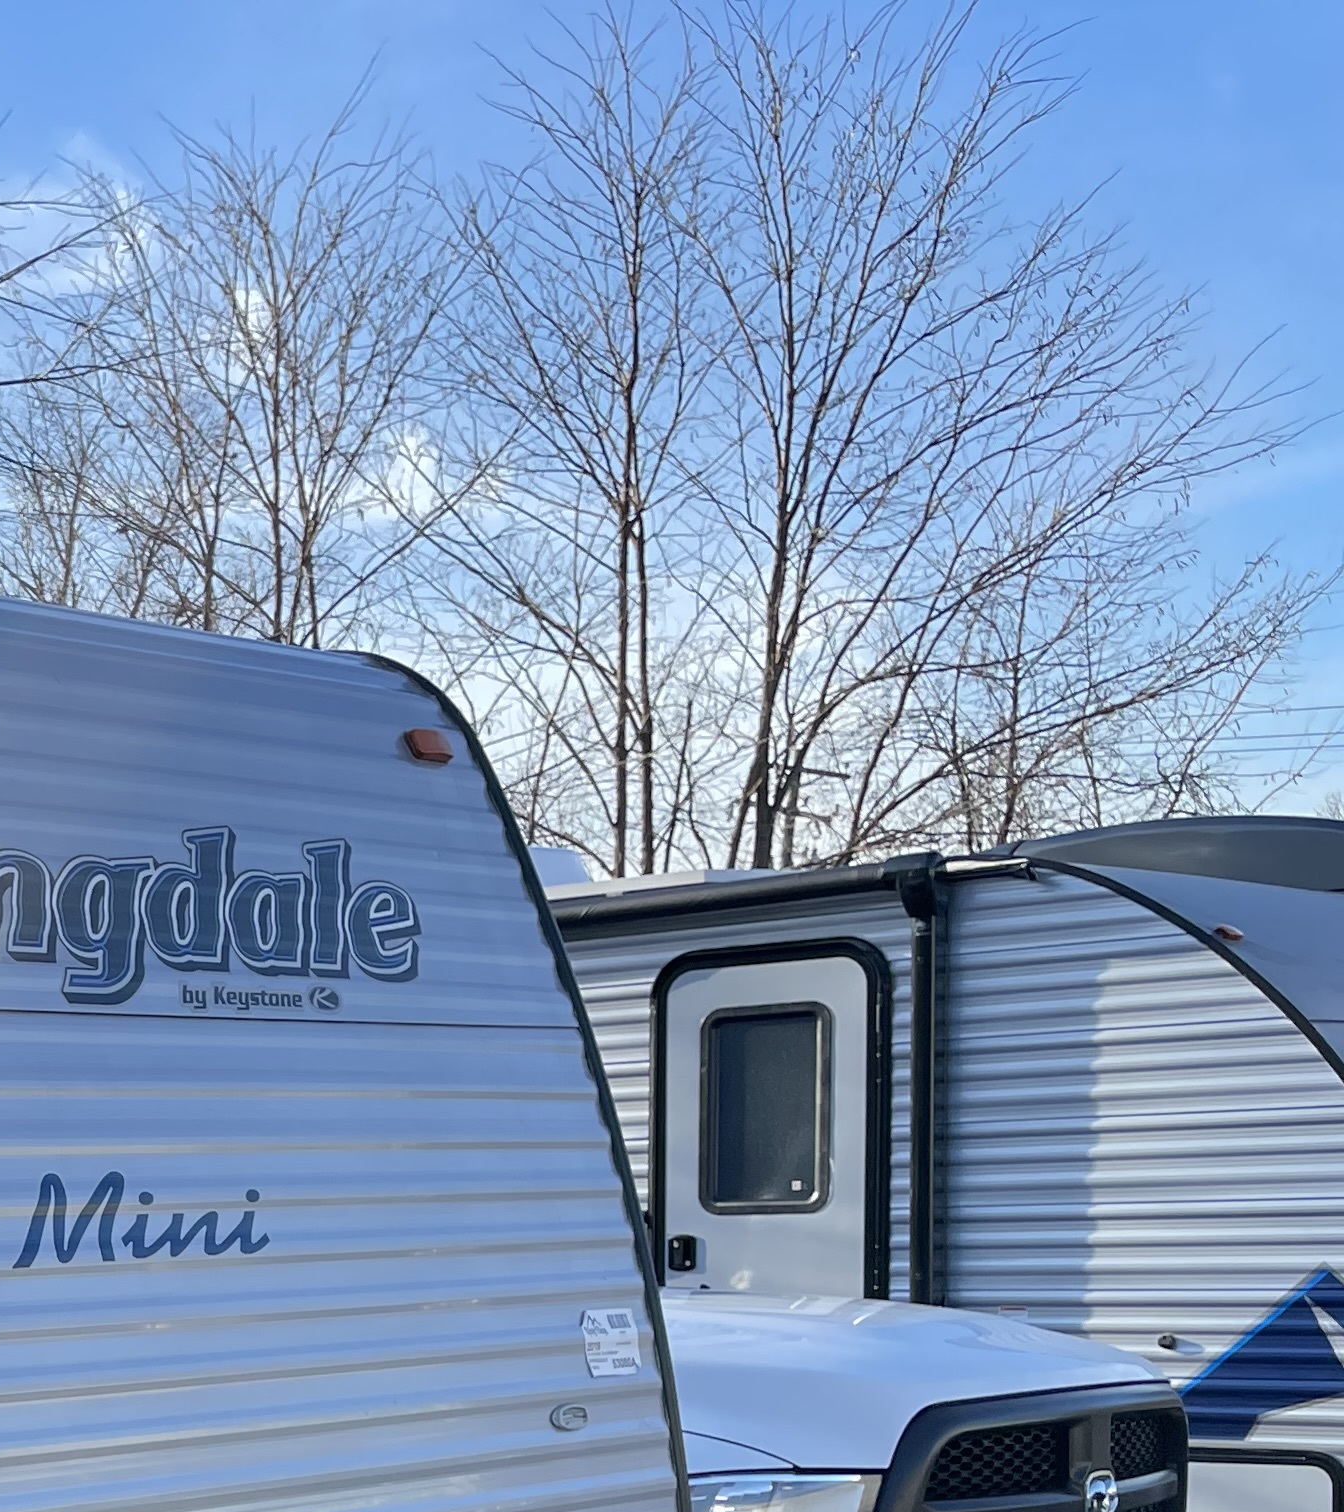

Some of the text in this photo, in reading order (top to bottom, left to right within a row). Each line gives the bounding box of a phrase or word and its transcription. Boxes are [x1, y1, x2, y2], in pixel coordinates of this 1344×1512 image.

[182, 984, 207, 1010] by
[213, 985, 304, 1011] Keystone
[12, 1171, 271, 1269] Mini
